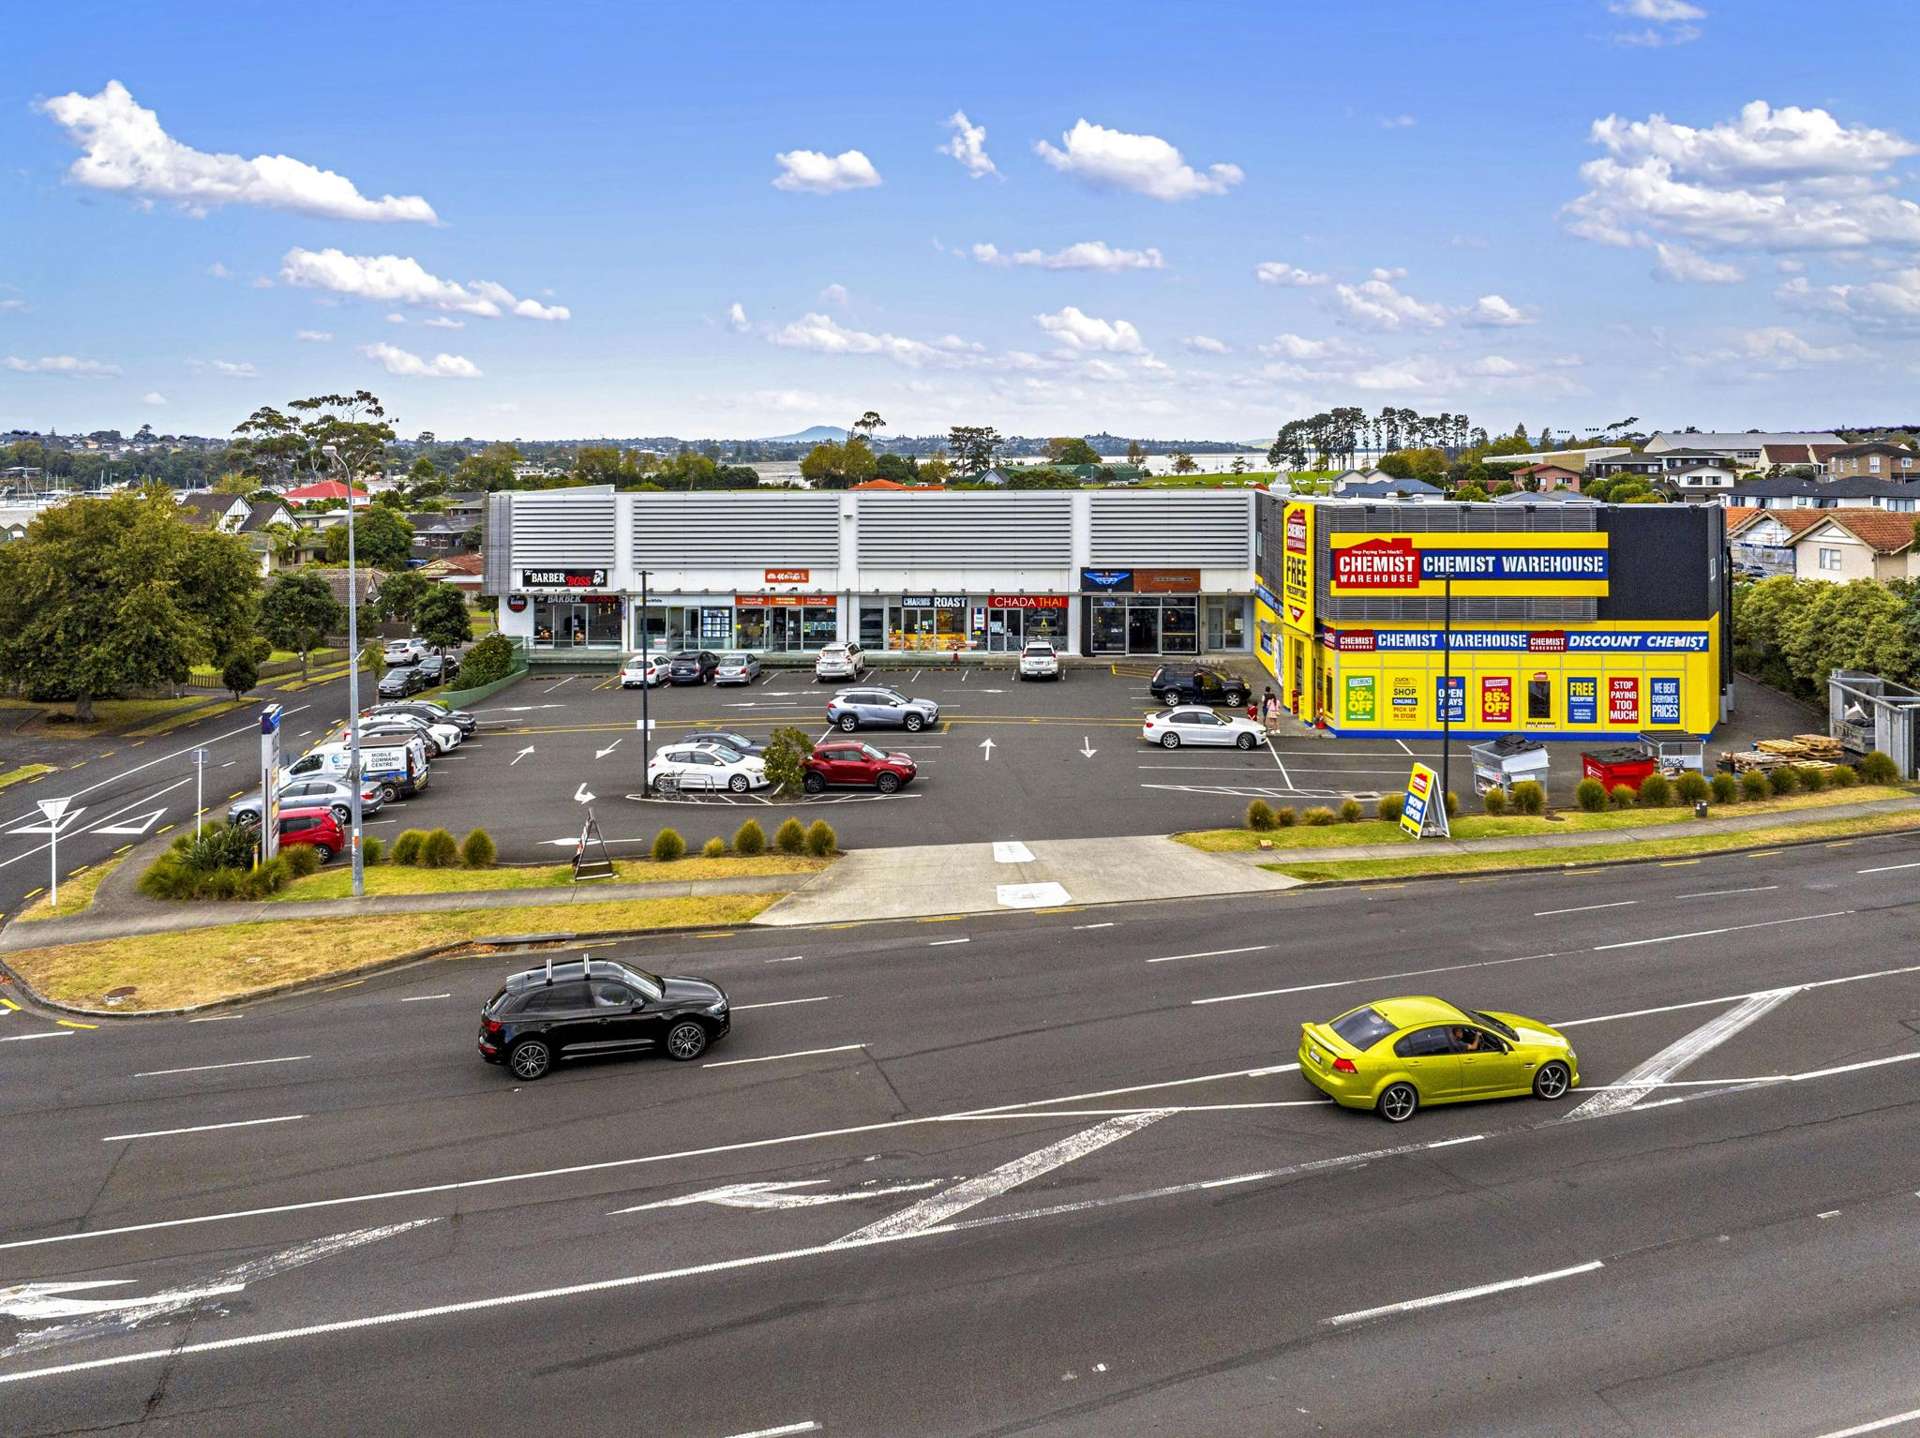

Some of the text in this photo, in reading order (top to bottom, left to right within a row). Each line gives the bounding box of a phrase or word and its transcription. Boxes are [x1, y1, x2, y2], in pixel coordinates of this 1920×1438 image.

[1339, 556, 1415, 572] CHEMIST
[1423, 556, 1604, 572] CHEMIST WAREHOUSE
[1286, 556, 1307, 588] FREE
[531, 572, 566, 583] BARBER
[566, 576, 591, 586] BOSS
[1339, 574, 1413, 583] WAREHOUSE
[547, 594, 581, 603] BARBER
[934, 597, 967, 607] ROAST
[994, 597, 1063, 607] CHADA THAI
[1340, 636, 1374, 644] CHEMIST
[1378, 634, 1527, 647] CHEMIST WAREHOUSE
[1530, 637, 1565, 645] CHEMIST
[1569, 635, 1707, 647] DISCOUNT CHEMIST
[1570, 682, 1595, 696] FREE
[1614, 681, 1634, 689] STOP
[1653, 683, 1677, 693] WE BEAT
[1349, 691, 1374, 701] 50%
[1394, 688, 1417, 696] SHOP
[1438, 689, 1463, 697] OEN
[1485, 692, 1510, 702] 85%
[1610, 691, 1637, 699] PAYING
[1348, 701, 1374, 712] OFF
[1484, 702, 1510, 713] OFF
[1616, 700, 1633, 710] TOO
[1610, 710, 1638, 720] MUCH!
[1652, 705, 1678, 718] PRICES
[1405, 804, 1421, 822] OPEN
